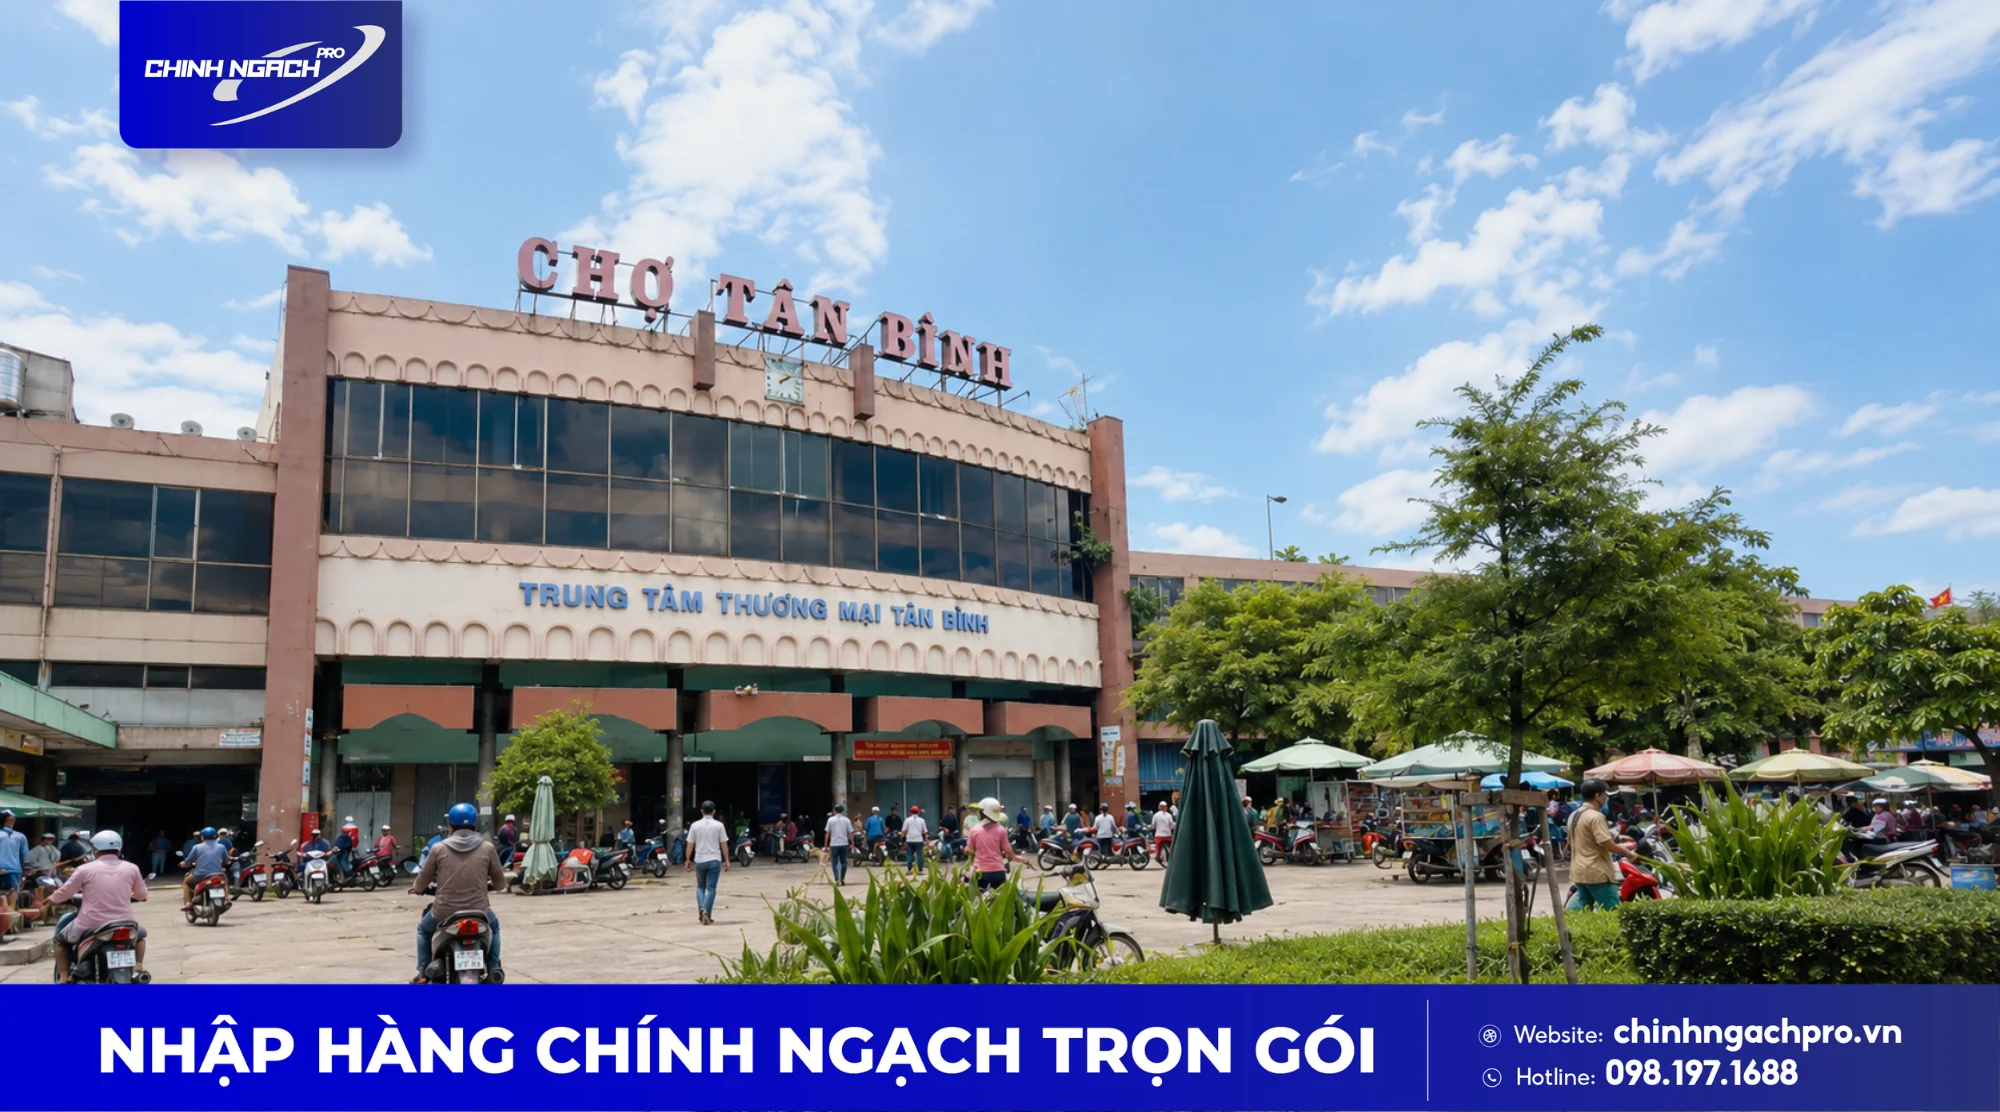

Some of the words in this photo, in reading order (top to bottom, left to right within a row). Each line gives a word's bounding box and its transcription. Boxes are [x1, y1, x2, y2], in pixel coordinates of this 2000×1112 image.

[517, 236, 674, 323] CHỢ
[716, 273, 850, 349] TÂN
[879, 310, 1013, 391] BÌNH
[519, 582, 628, 609] TRUNG
[642, 583, 703, 613] TÂM
[716, 592, 828, 620] THƯƠNG
[838, 600, 881, 627] MẠI
[890, 602, 933, 628] TÂN
[942, 605, 989, 633] BÌNH
